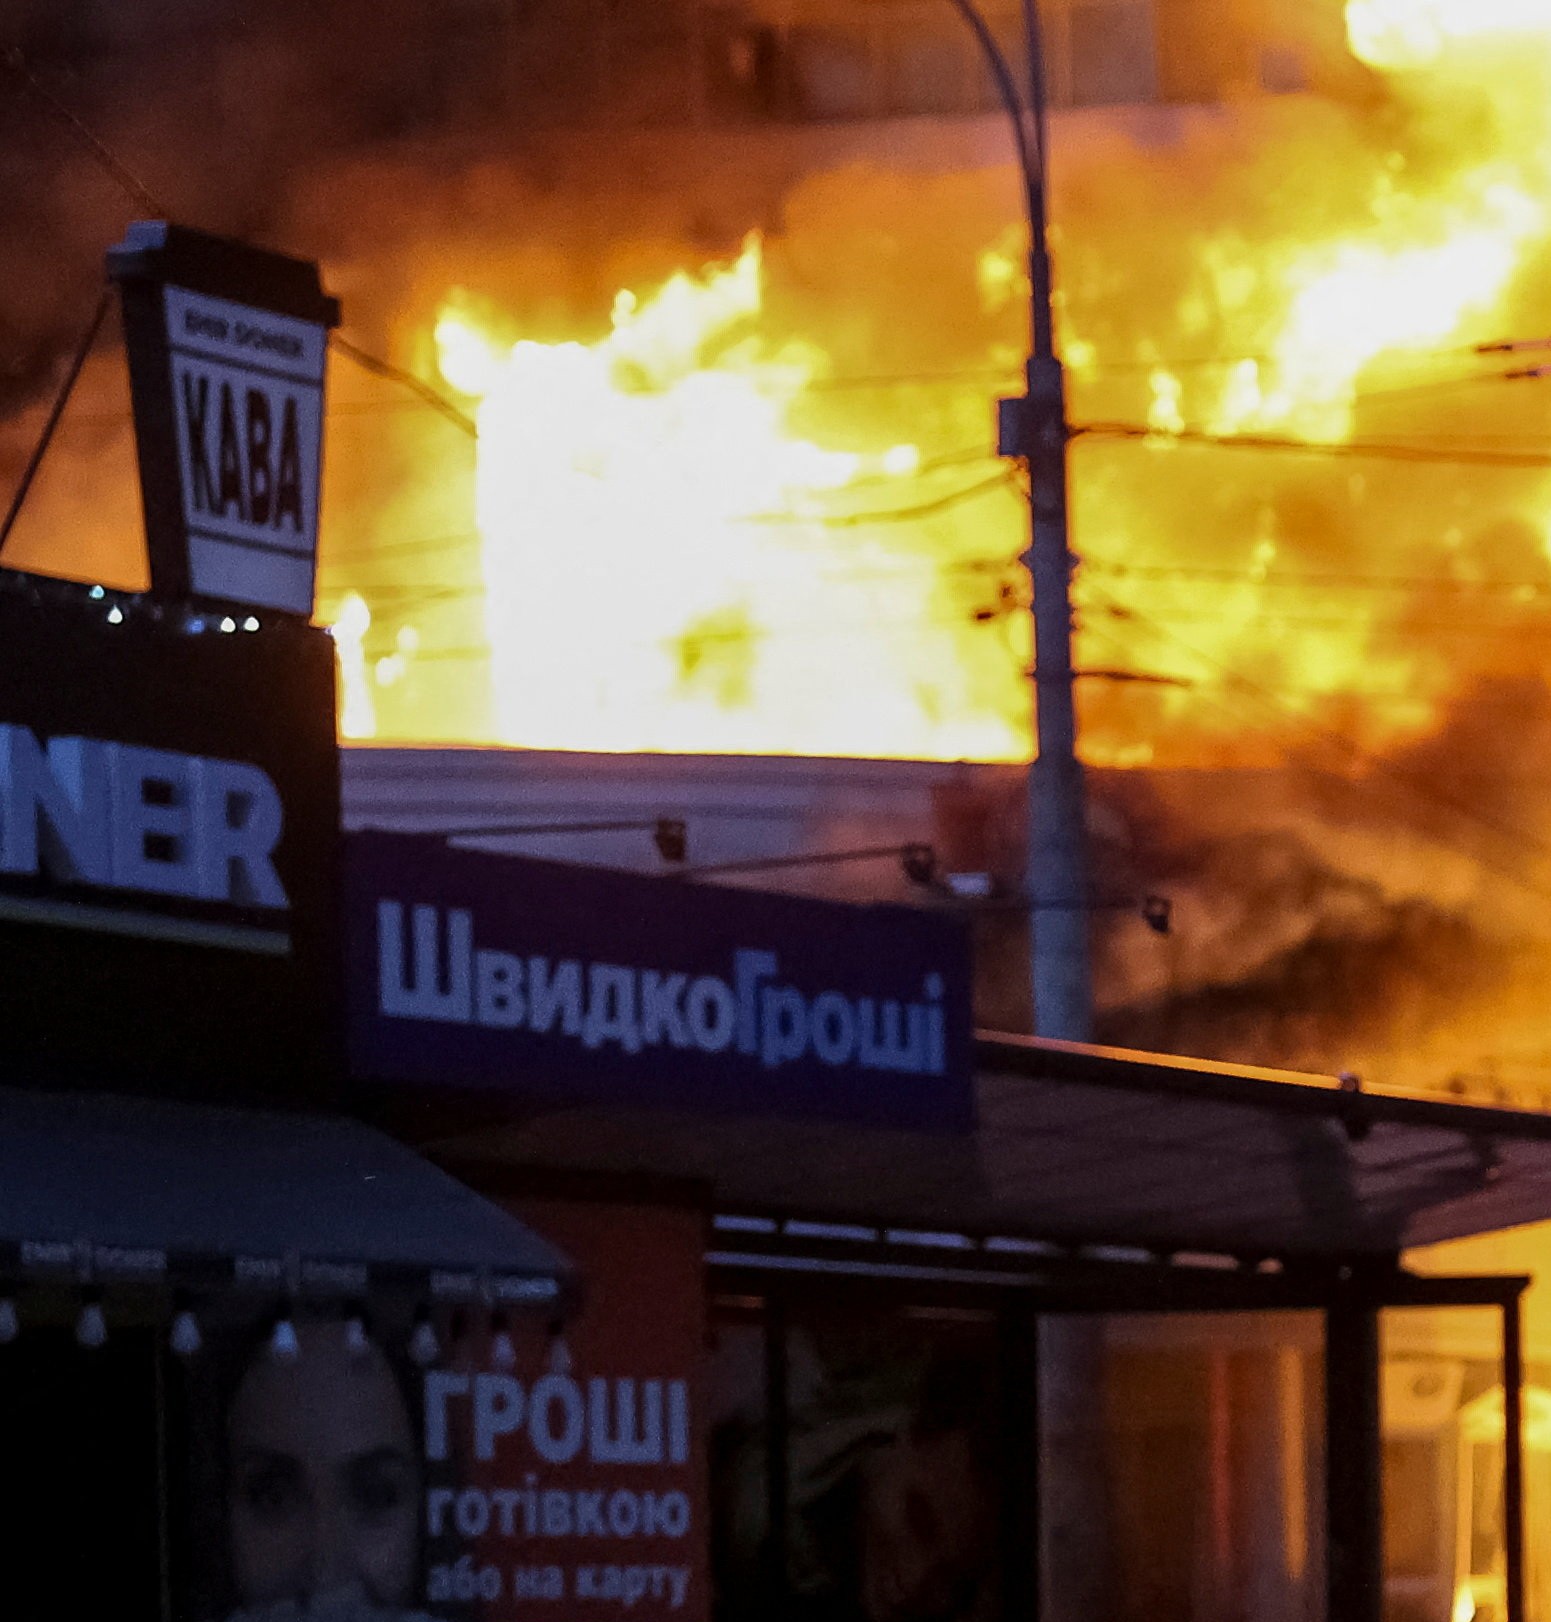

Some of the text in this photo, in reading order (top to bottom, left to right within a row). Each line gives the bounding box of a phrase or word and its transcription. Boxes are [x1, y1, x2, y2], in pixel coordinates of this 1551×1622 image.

[182, 369, 303, 534] КАВА
[376, 897, 947, 1077] ШвидкоГроші
[424, 1369, 690, 1464] ГРОШІ
[426, 1472, 692, 1539] готівкою
[427, 1555, 693, 1609] або на карту
